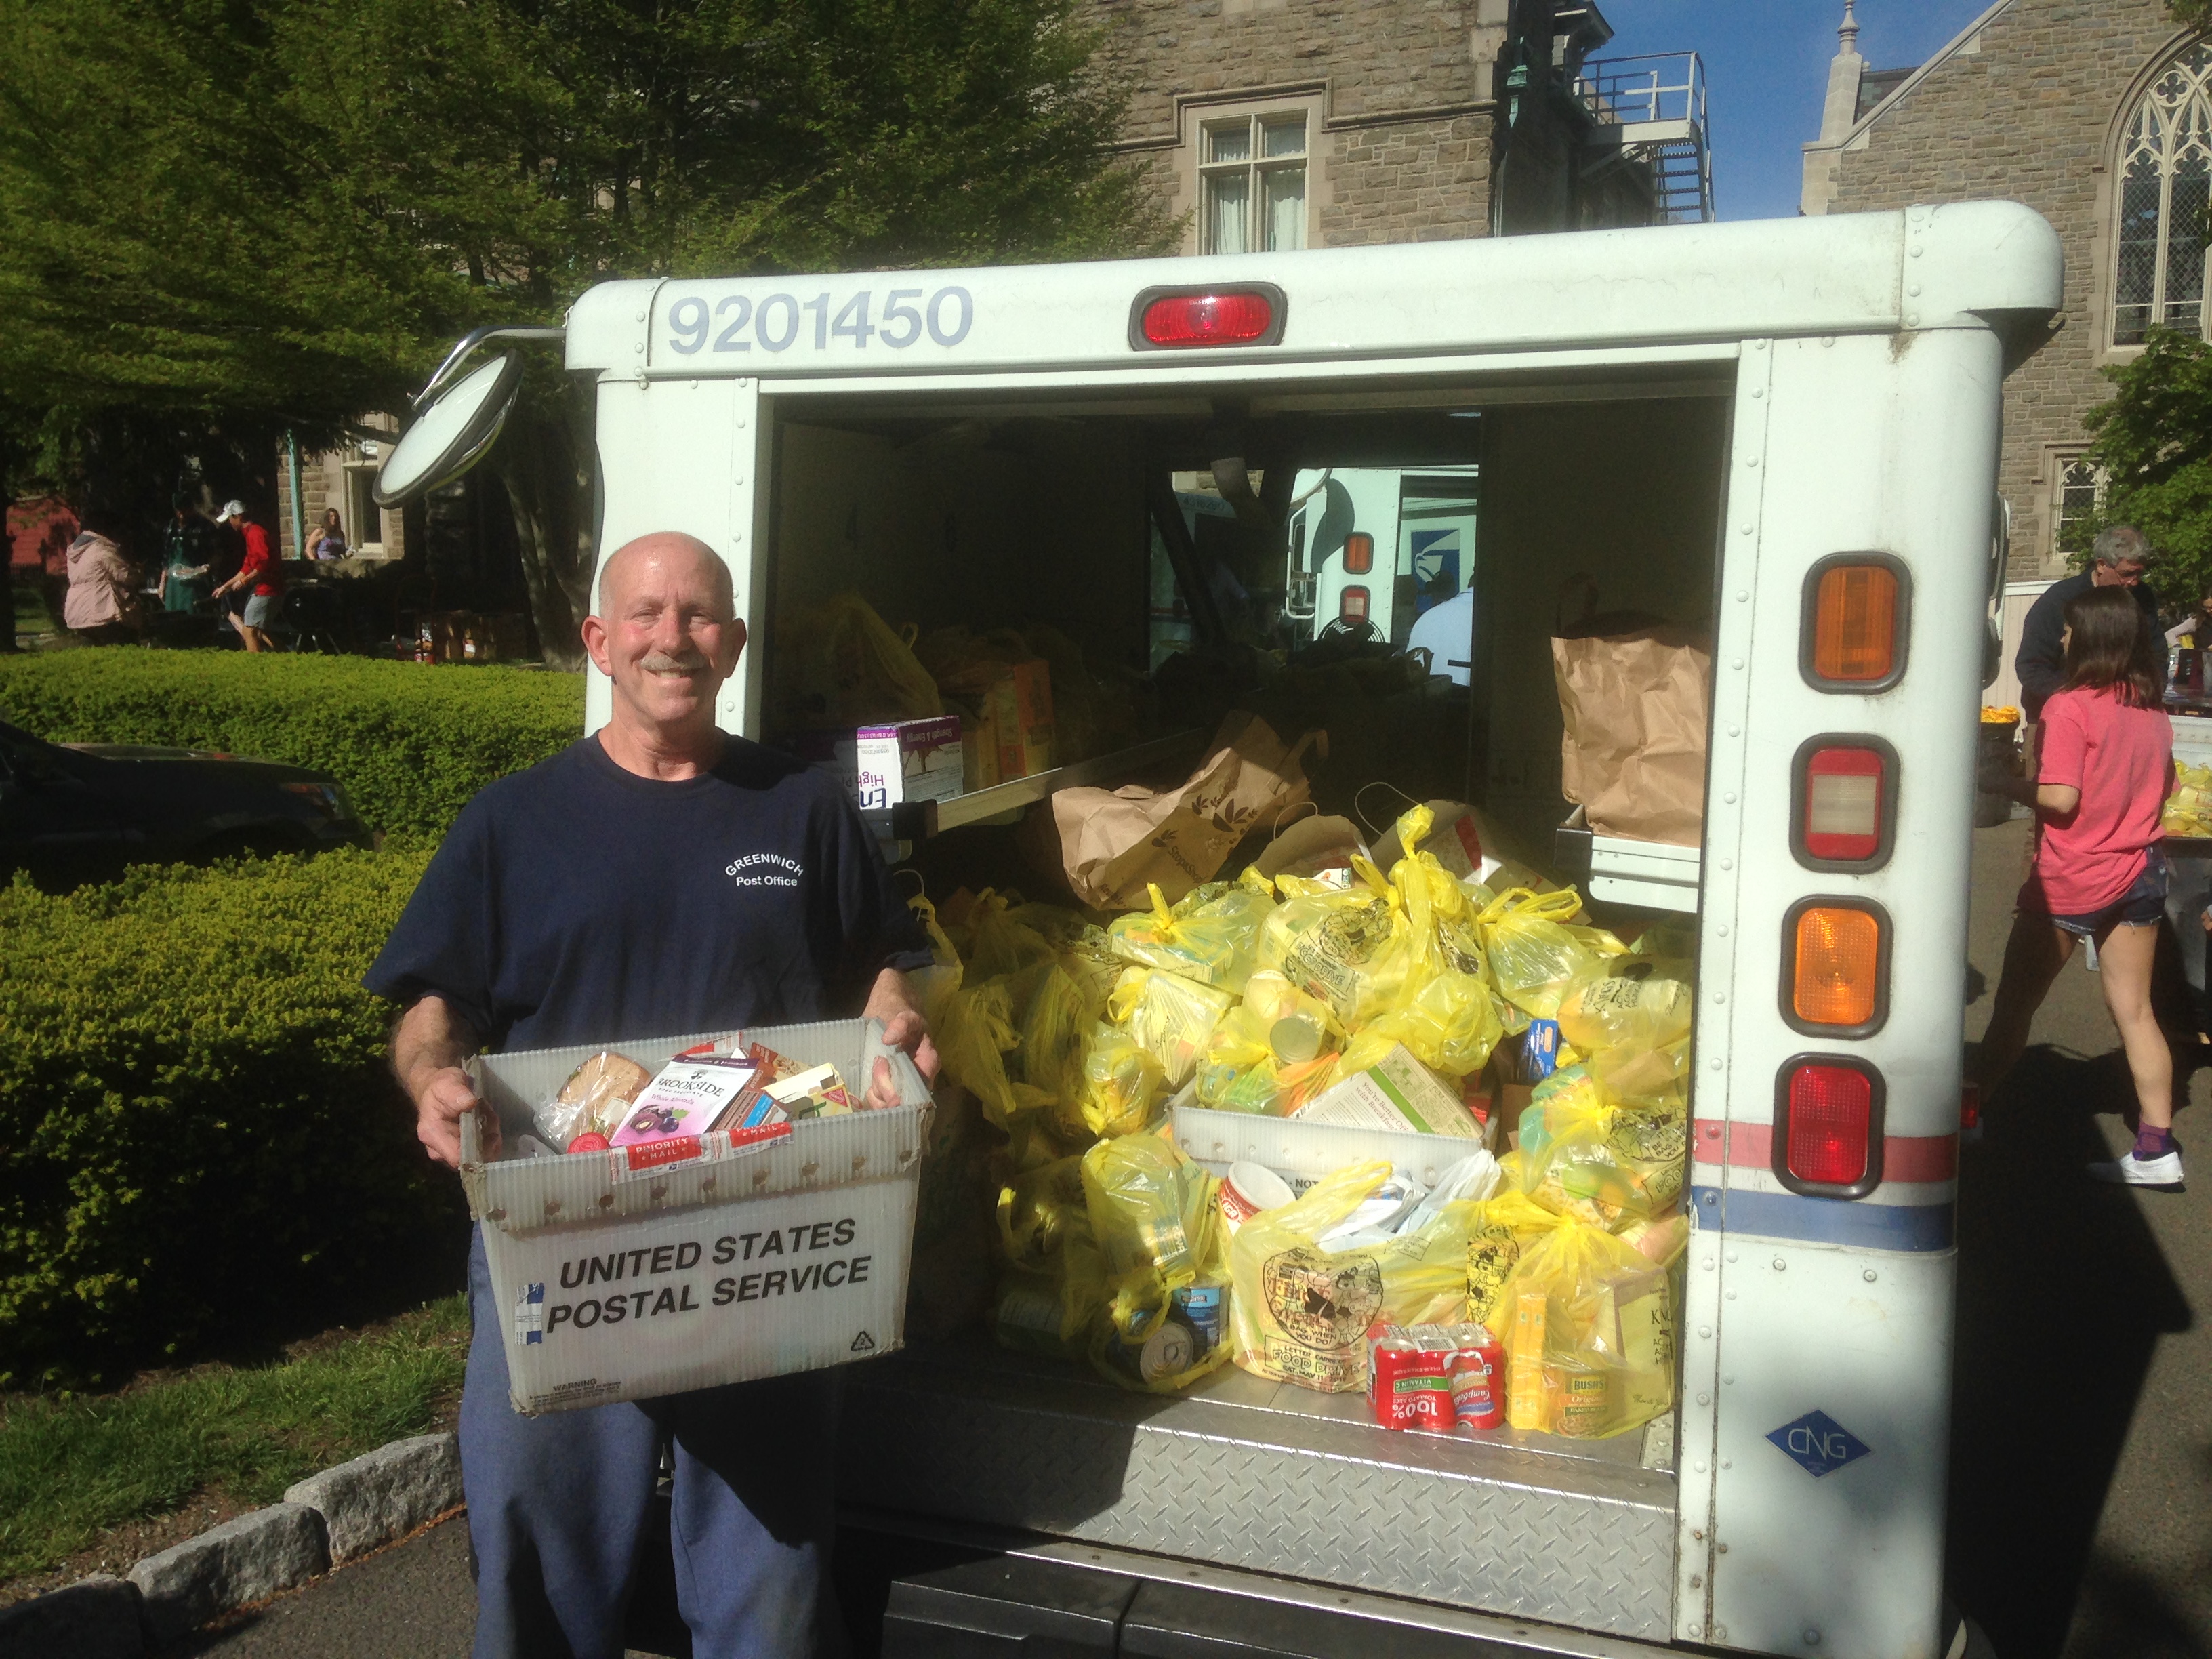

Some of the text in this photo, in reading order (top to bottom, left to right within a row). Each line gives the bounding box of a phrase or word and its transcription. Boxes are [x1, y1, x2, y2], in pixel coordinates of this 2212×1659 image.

[668, 285, 973, 355] 9201450
[857, 772, 884, 787] High
[725, 853, 804, 876] GREENWICH
[736, 876, 798, 886] Post Office
[1355, 1086, 1369, 1101] with
[1362, 1081, 1380, 1103] You're
[1378, 1101, 1395, 1121] Better
[750, 1125, 778, 1136] MAIL
[636, 1137, 689, 1155] PRIORITY
[649, 1148, 678, 1160] MAIL
[1222, 1201, 1239, 1218] IGA
[560, 1218, 855, 1289] UNITED STATES
[546, 1286, 699, 1334] POSTAL
[712, 1256, 872, 1306] SERVICE
[1290, 1324, 1337, 1340] BAG WHEN
[1296, 1332, 1332, 1345] YOU DO!
[1284, 1345, 1311, 1357] LETTER
[1273, 1349, 1360, 1375] FOOD DRIVE
[553, 1378, 598, 1391] WARNING
[1401, 1378, 1431, 1387] VITAMIN
[1574, 1380, 1604, 1391] BUSH'S
[1392, 1400, 1439, 1420] 100%
[1788, 1425, 1847, 1460] CNG
